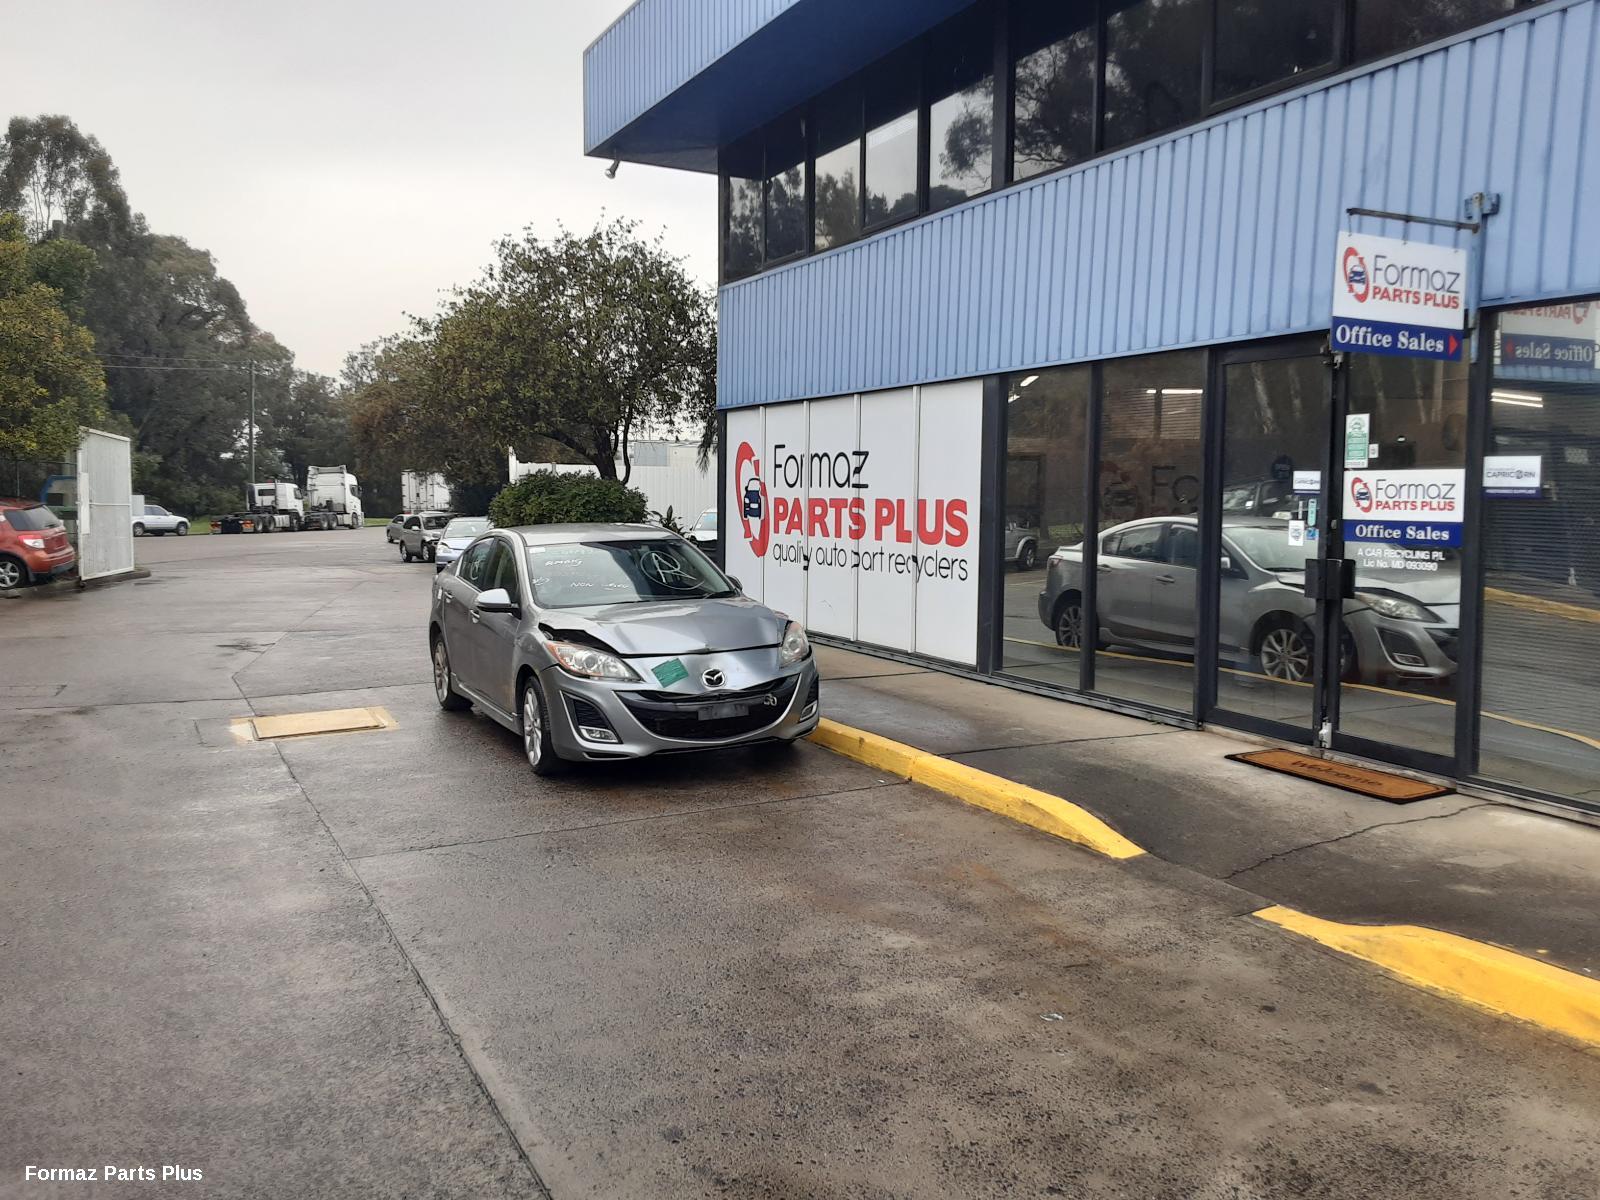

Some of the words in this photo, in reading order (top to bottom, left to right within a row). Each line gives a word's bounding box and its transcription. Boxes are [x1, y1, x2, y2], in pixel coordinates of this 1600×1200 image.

[1373, 255, 1460, 293] Formaz
[1372, 285, 1420, 305] PARTS
[1423, 295, 1459, 309] PLUS
[1336, 324, 1392, 347] Office
[1397, 331, 1444, 352] Sales
[773, 444, 869, 489] Formaz
[1375, 479, 1456, 500] Formaz
[1375, 500, 1417, 511] PARTS
[1420, 501, 1455, 511] PLUS
[773, 497, 866, 540] PARTS
[874, 498, 969, 548] PLUS
[1355, 524, 1402, 539] Office
[1405, 526, 1450, 541] Sales
[772, 540, 812, 571] qualiy
[815, 542, 847, 567] auto
